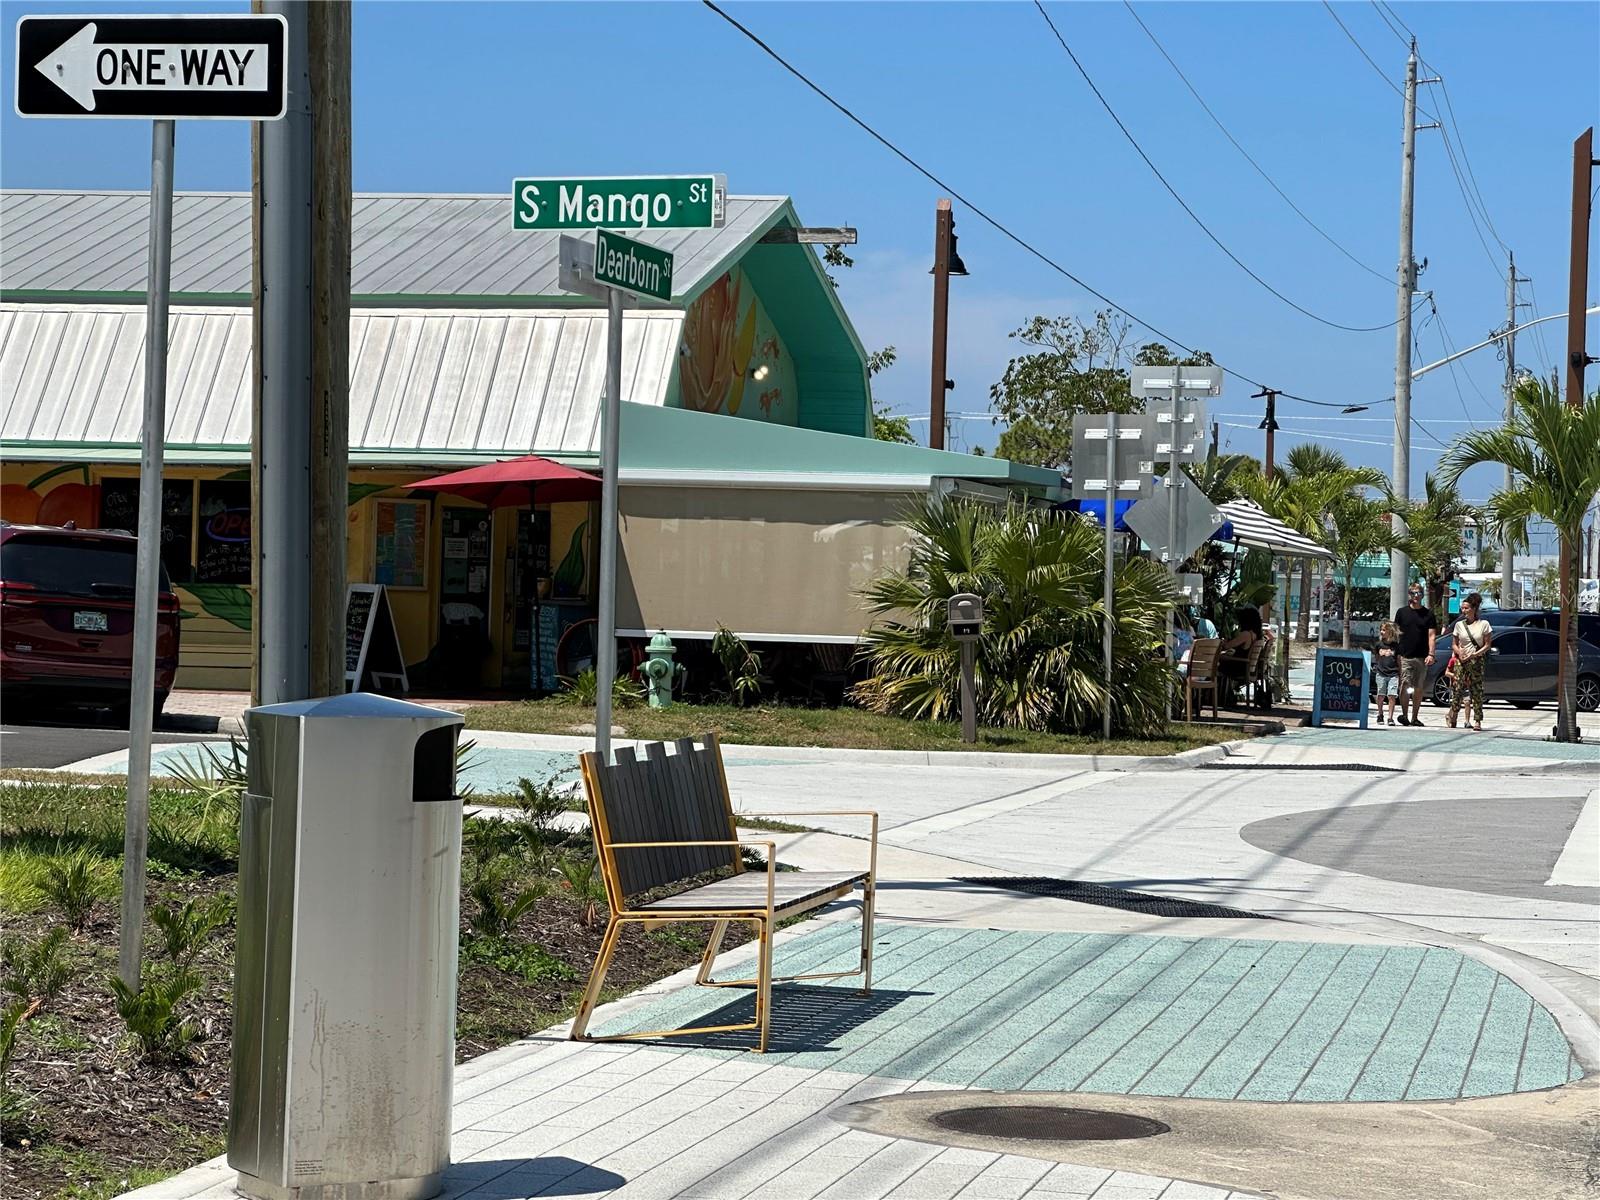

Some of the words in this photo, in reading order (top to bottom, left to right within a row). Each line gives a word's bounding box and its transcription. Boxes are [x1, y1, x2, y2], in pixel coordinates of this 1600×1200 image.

[96, 48, 166, 86] ONE
[180, 48, 255, 86] WAY
[519, 184, 540, 224] S
[558, 184, 672, 229] Mango
[688, 182, 708, 204] St
[596, 235, 660, 293] Dearborn
[663, 256, 671, 278] St
[212, 513, 251, 535] OPE
[1326, 661, 1353, 679] JOY
[1324, 682, 1351, 696] Eating
[1328, 699, 1353, 711] LOVE
